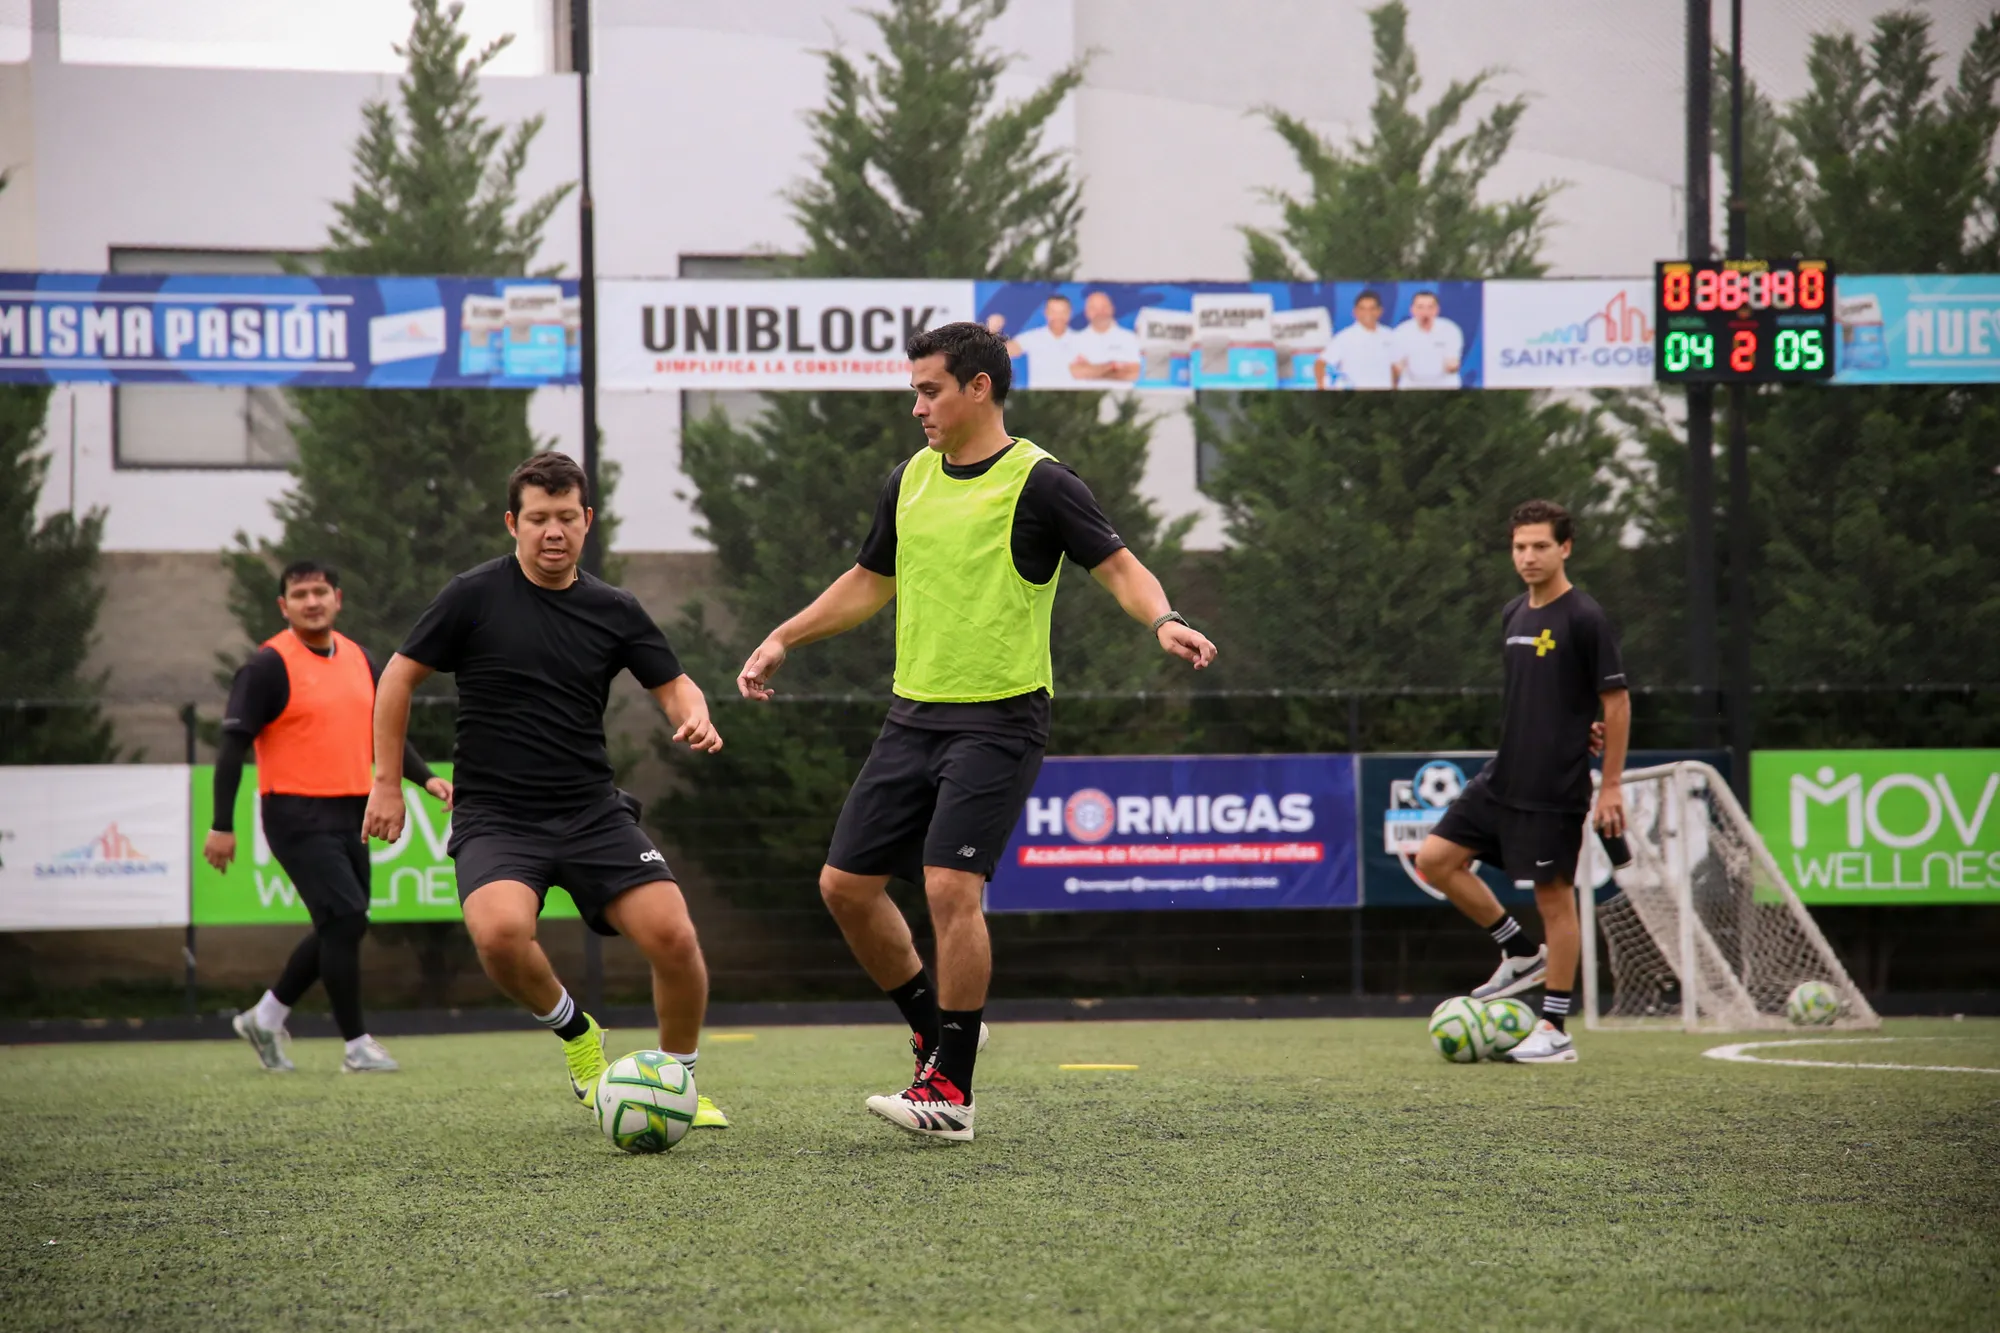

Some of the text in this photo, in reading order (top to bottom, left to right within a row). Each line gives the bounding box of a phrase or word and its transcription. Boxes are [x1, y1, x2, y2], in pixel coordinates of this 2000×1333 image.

[0, 300, 347, 359] MISMA PASIÓN
[641, 305, 935, 353] UNIBLOCK
[655, 360, 757, 374] SIMPLIFICA
[764, 360, 785, 373] LA
[1499, 346, 1655, 368] SAINT-GOB
[1665, 332, 1713, 372] 04
[1730, 331, 1757, 372] 2
[1775, 330, 1824, 371] 05
[1026, 788, 1315, 842] HORMIGAS
[1393, 823, 1436, 841] UNI
